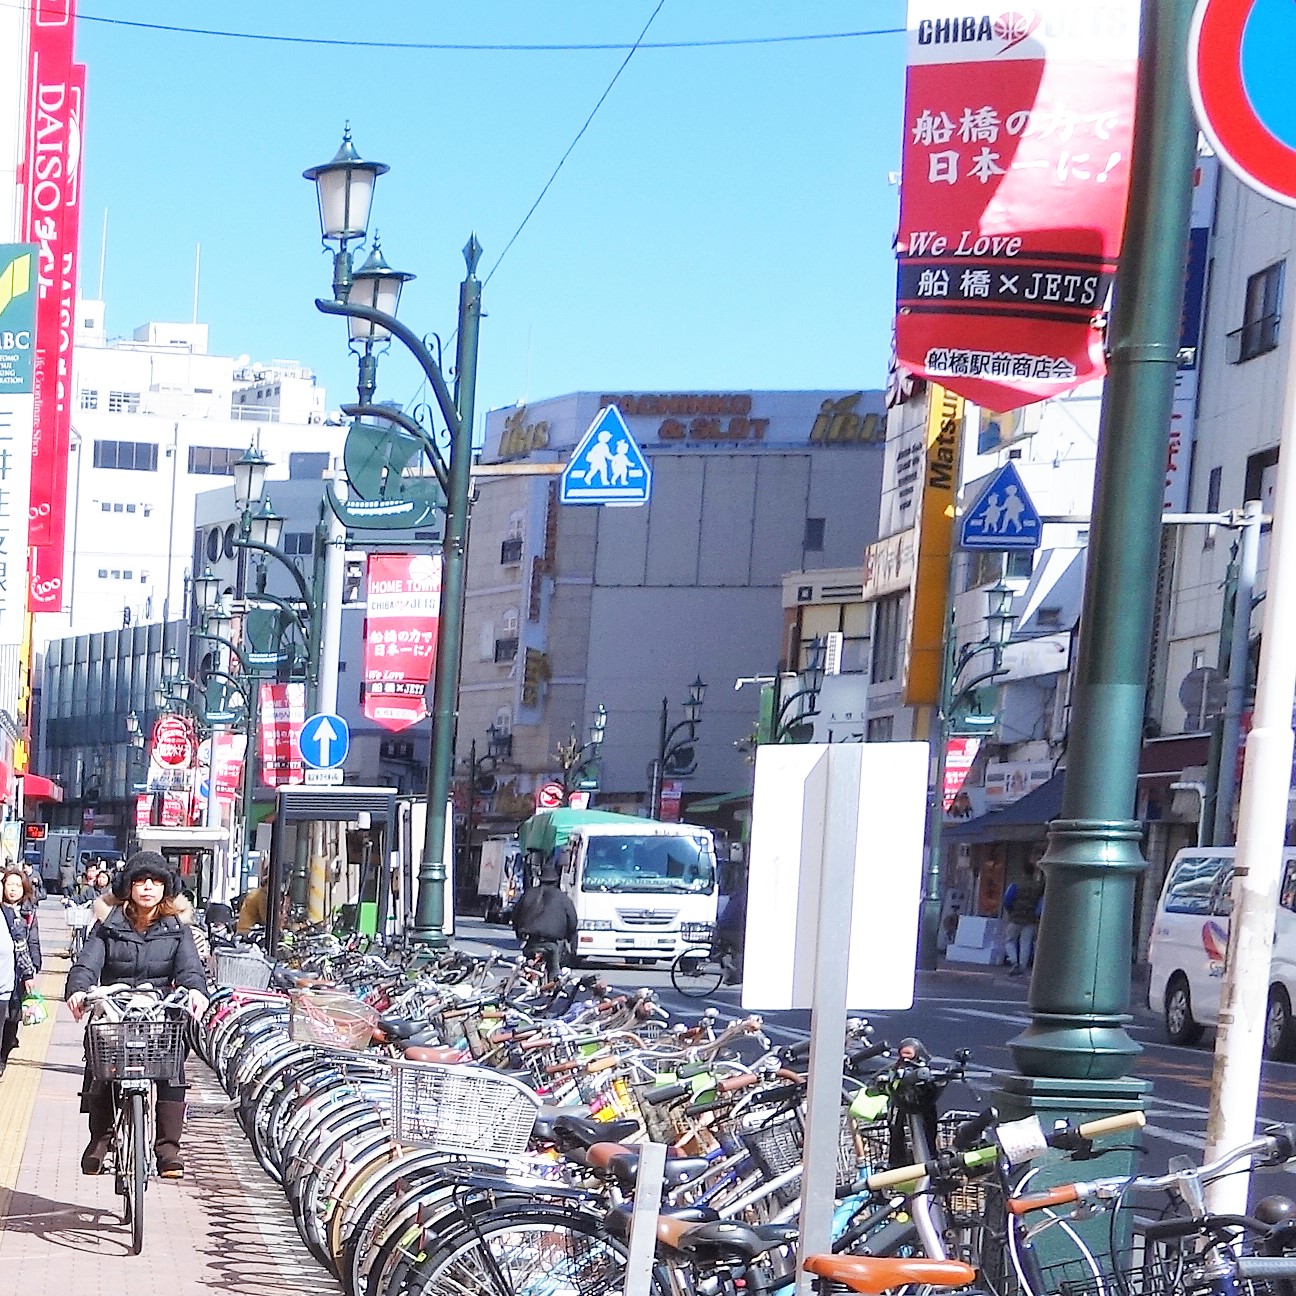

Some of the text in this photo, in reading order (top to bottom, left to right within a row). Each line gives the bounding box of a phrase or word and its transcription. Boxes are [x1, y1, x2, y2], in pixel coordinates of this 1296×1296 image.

[918, 16, 992, 45] CHIBA
[911, 104, 1119, 148] 船橋の力で
[34, 82, 66, 213] DAISO
[927, 148, 1123, 186] 日本一に!
[907, 230, 1022, 257] We Love
[927, 348, 1076, 380] 船橋駅前商店会
[371, 580, 403, 594] HOME
[371, 600, 395, 611] CHIBA
